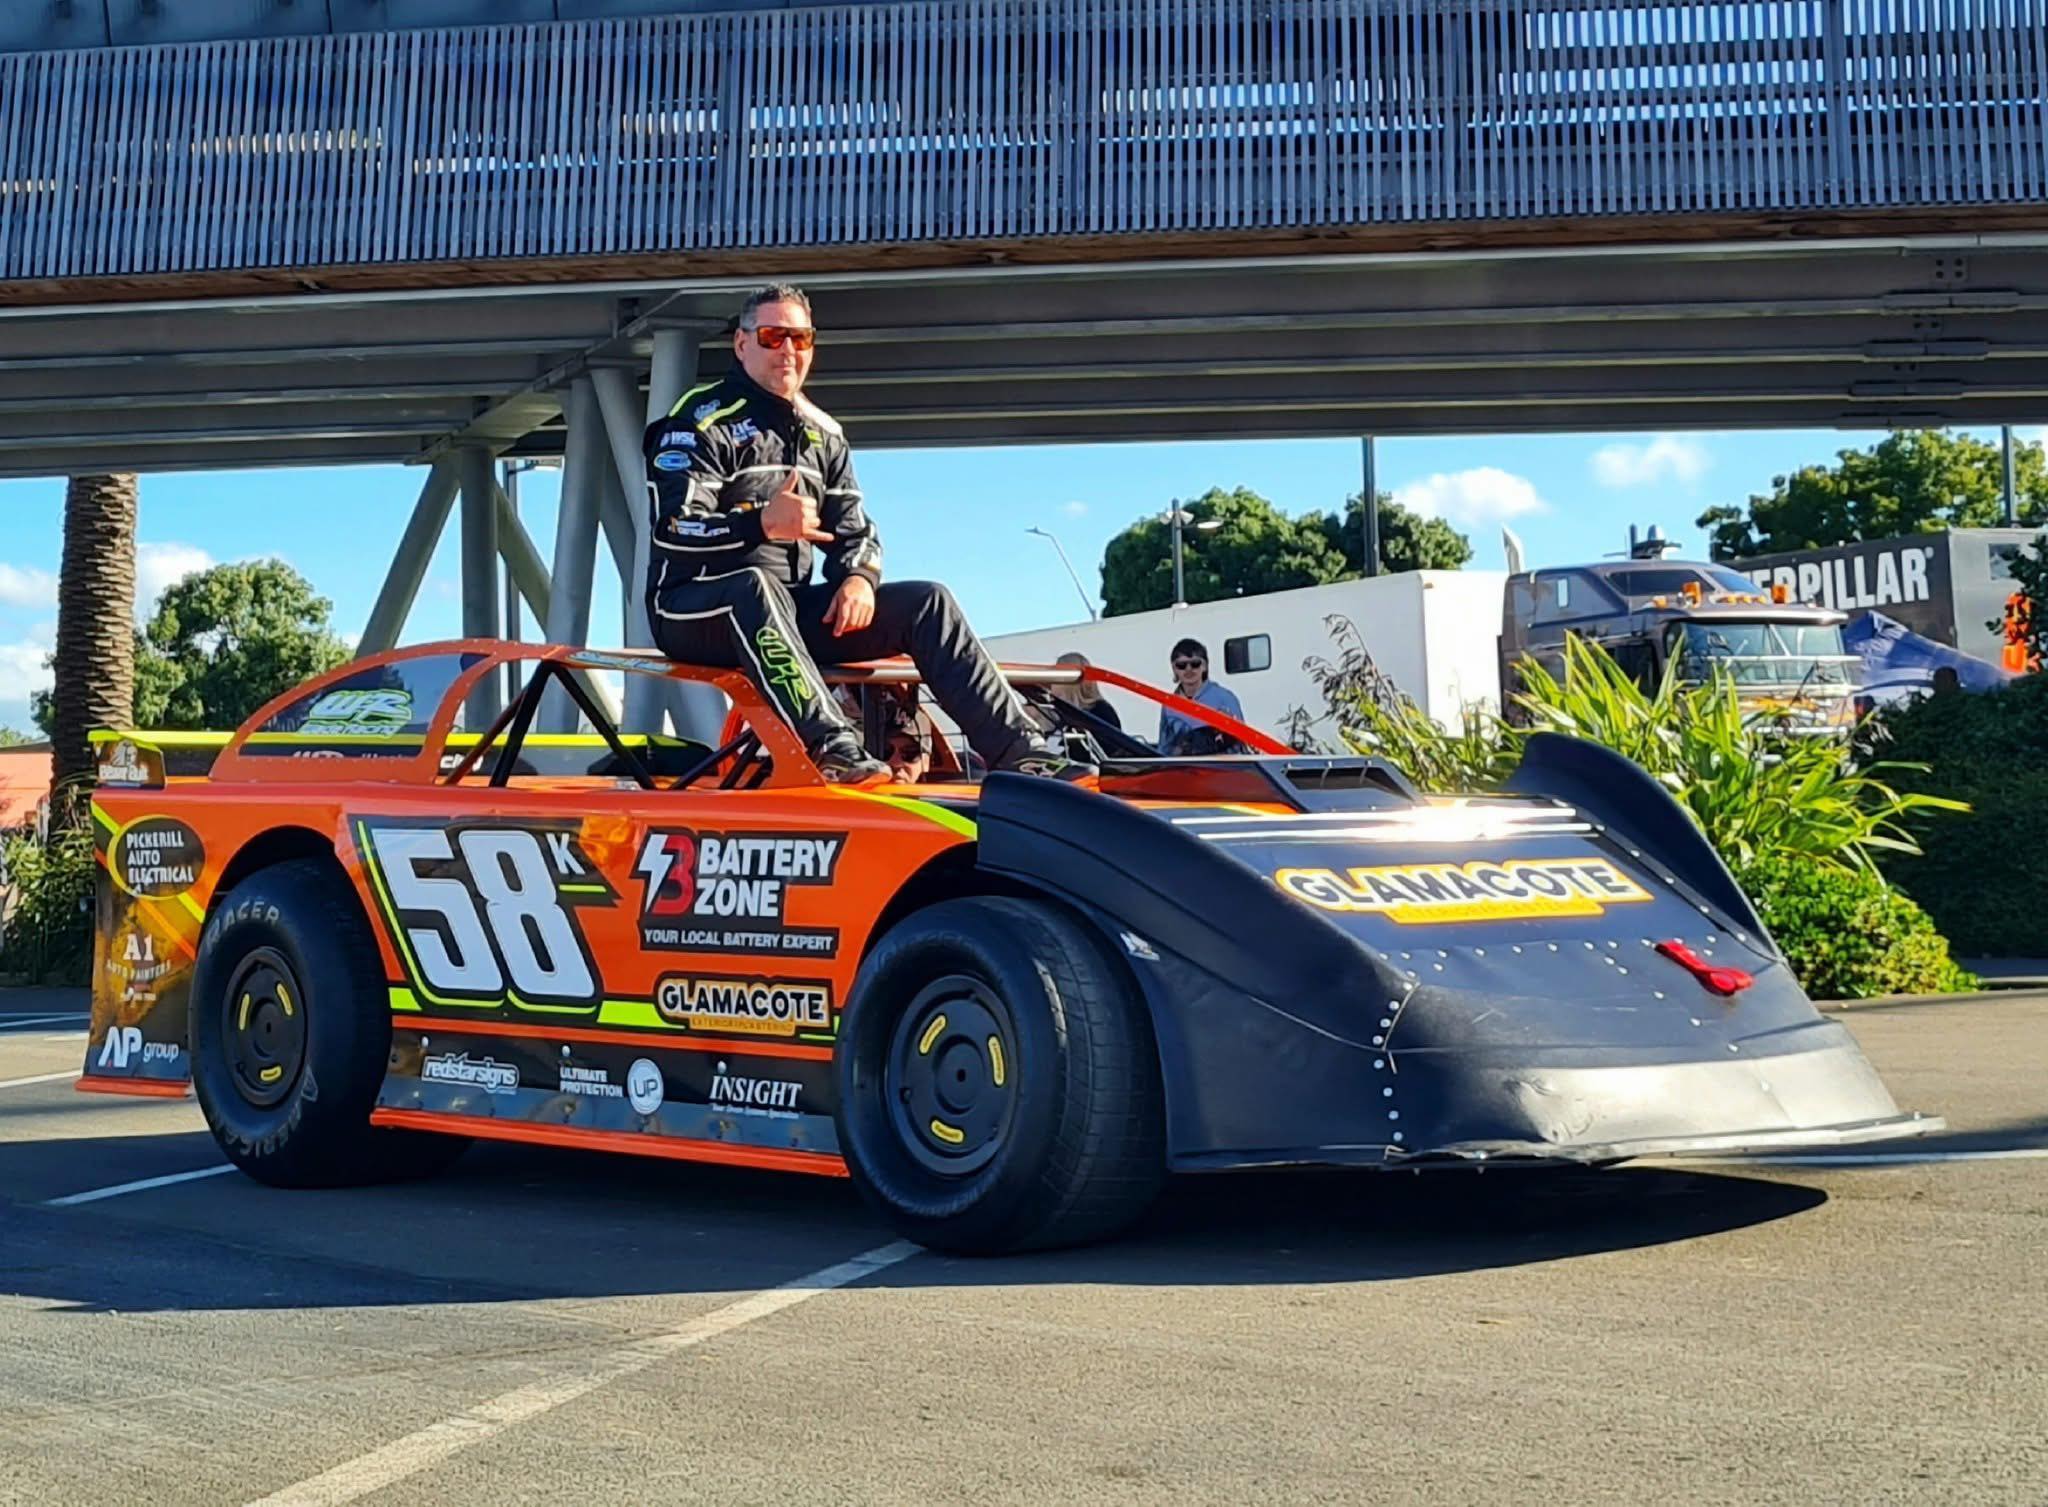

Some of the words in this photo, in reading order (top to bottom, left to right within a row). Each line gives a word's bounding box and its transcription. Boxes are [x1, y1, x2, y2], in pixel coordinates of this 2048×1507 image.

[1744, 548, 1930, 610] ERPILLAR
[126, 831, 184, 849] PICKERILL
[127, 849, 161, 866] AUTO
[699, 838, 837, 877] BATTERY
[128, 866, 194, 884] ELECTRICAL
[1288, 866, 1630, 904] GLAMACOTE
[694, 878, 780, 917] ZONE
[122, 933, 154, 961] A1
[645, 929, 679, 943] YOUR
[681, 930, 720, 945] LOCAL
[723, 932, 780, 948] BATTERY
[782, 934, 833, 950] EXPERT
[662, 984, 824, 1021] GLAMACOTE
[99, 1026, 142, 1068] AP
[143, 1042, 179, 1063] group
[424, 1057, 517, 1088] redstarsigns
[560, 1067, 608, 1083] ULTIMATE
[560, 1081, 624, 1098] PROTECTION
[708, 1075, 803, 1108] INSIGHT
